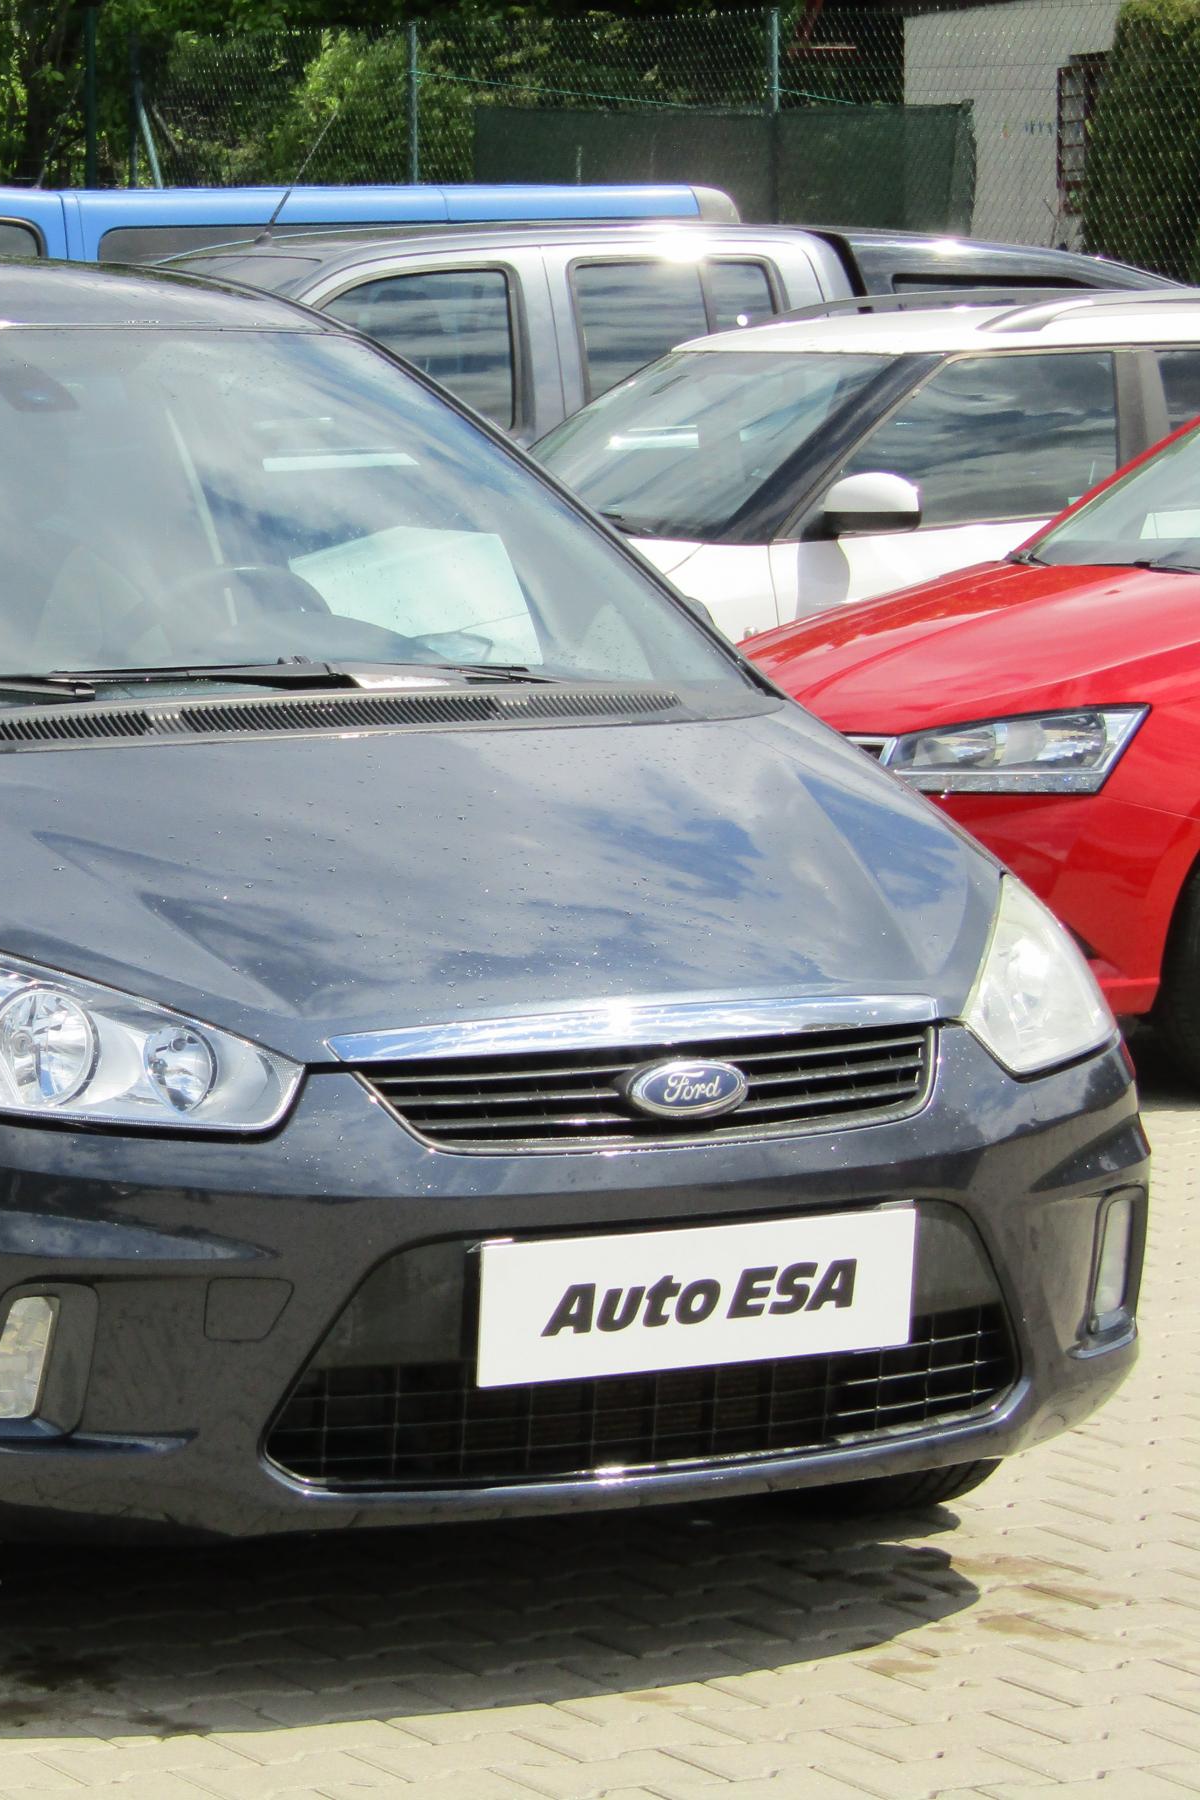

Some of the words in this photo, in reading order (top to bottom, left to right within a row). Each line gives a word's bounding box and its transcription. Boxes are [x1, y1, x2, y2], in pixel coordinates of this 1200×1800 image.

[664, 1071, 722, 1102] Ford
[540, 1275, 721, 1337] Auto
[726, 1258, 857, 1319] ESA
